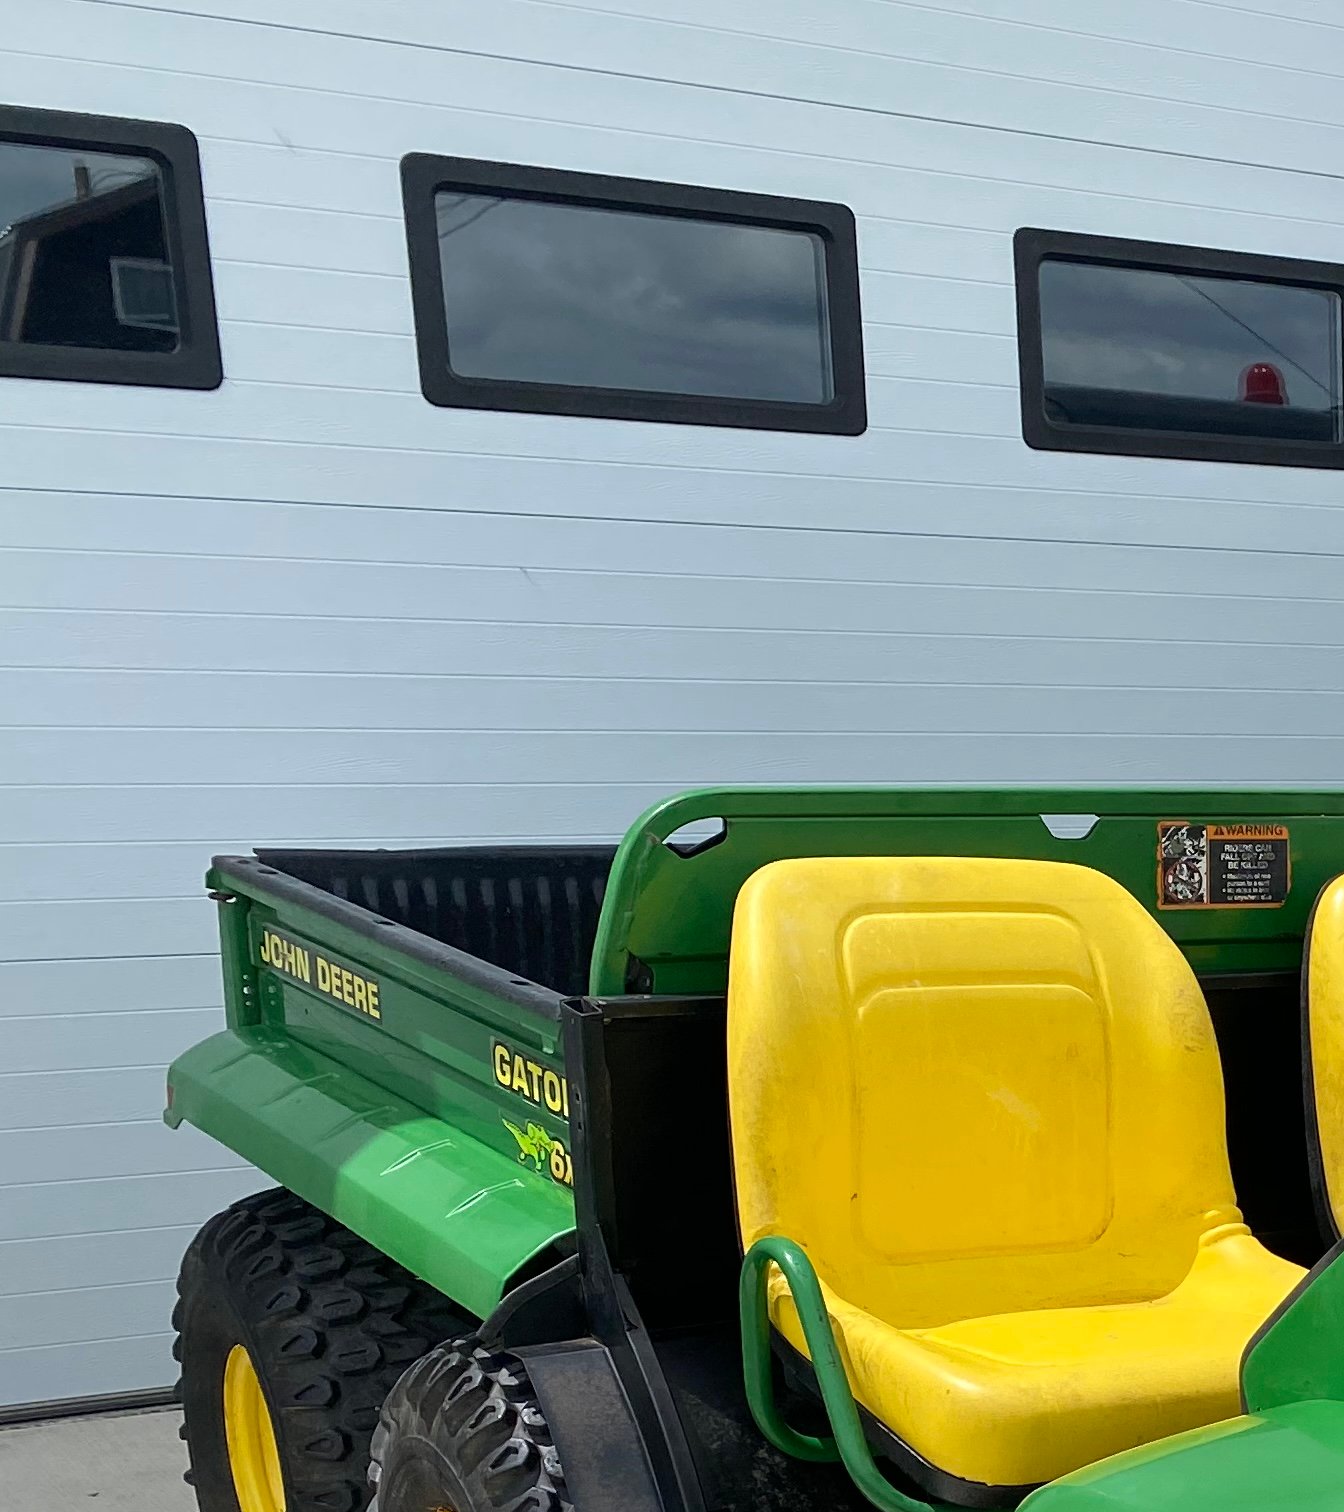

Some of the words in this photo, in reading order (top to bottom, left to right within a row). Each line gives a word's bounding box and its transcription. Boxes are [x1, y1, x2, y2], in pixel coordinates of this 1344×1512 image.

[1225, 825, 1283, 836] WARNING
[1220, 852, 1240, 860] FALL
[260, 930, 311, 984] JOHN
[316, 956, 381, 1019] DEERE
